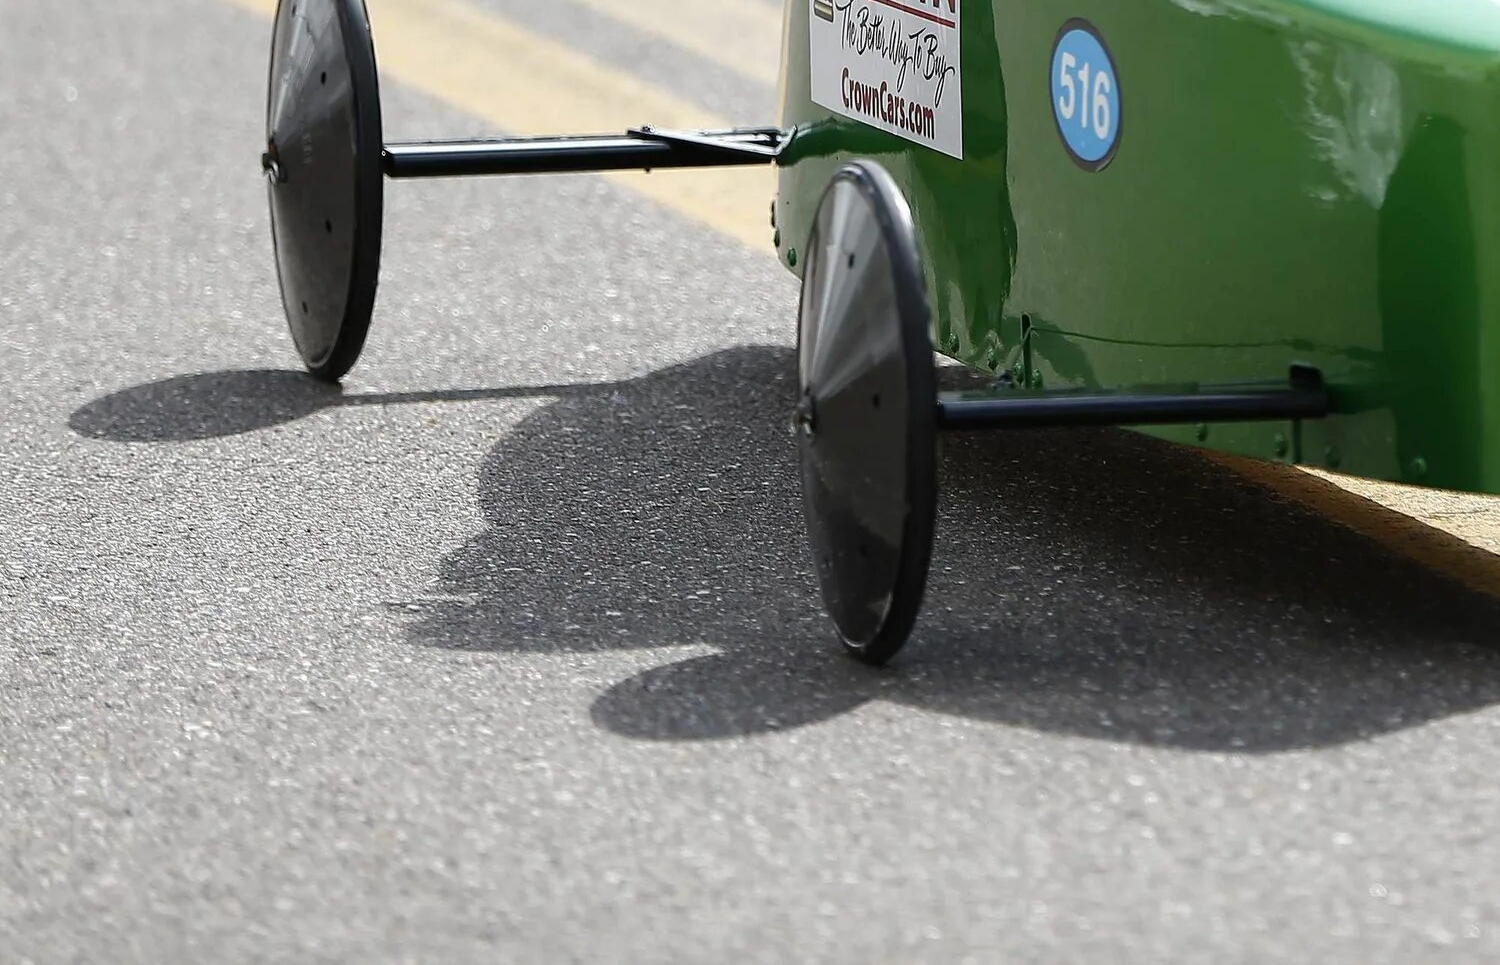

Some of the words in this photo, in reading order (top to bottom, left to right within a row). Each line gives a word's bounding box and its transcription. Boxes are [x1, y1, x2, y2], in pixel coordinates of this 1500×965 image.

[857, 6, 888, 58] Better
[888, 19, 913, 93] Way
[908, 27, 926, 75] To
[923, 34, 956, 109] Buy
[1059, 52, 1110, 140] 516
[842, 67, 935, 140] CrownCars.com
